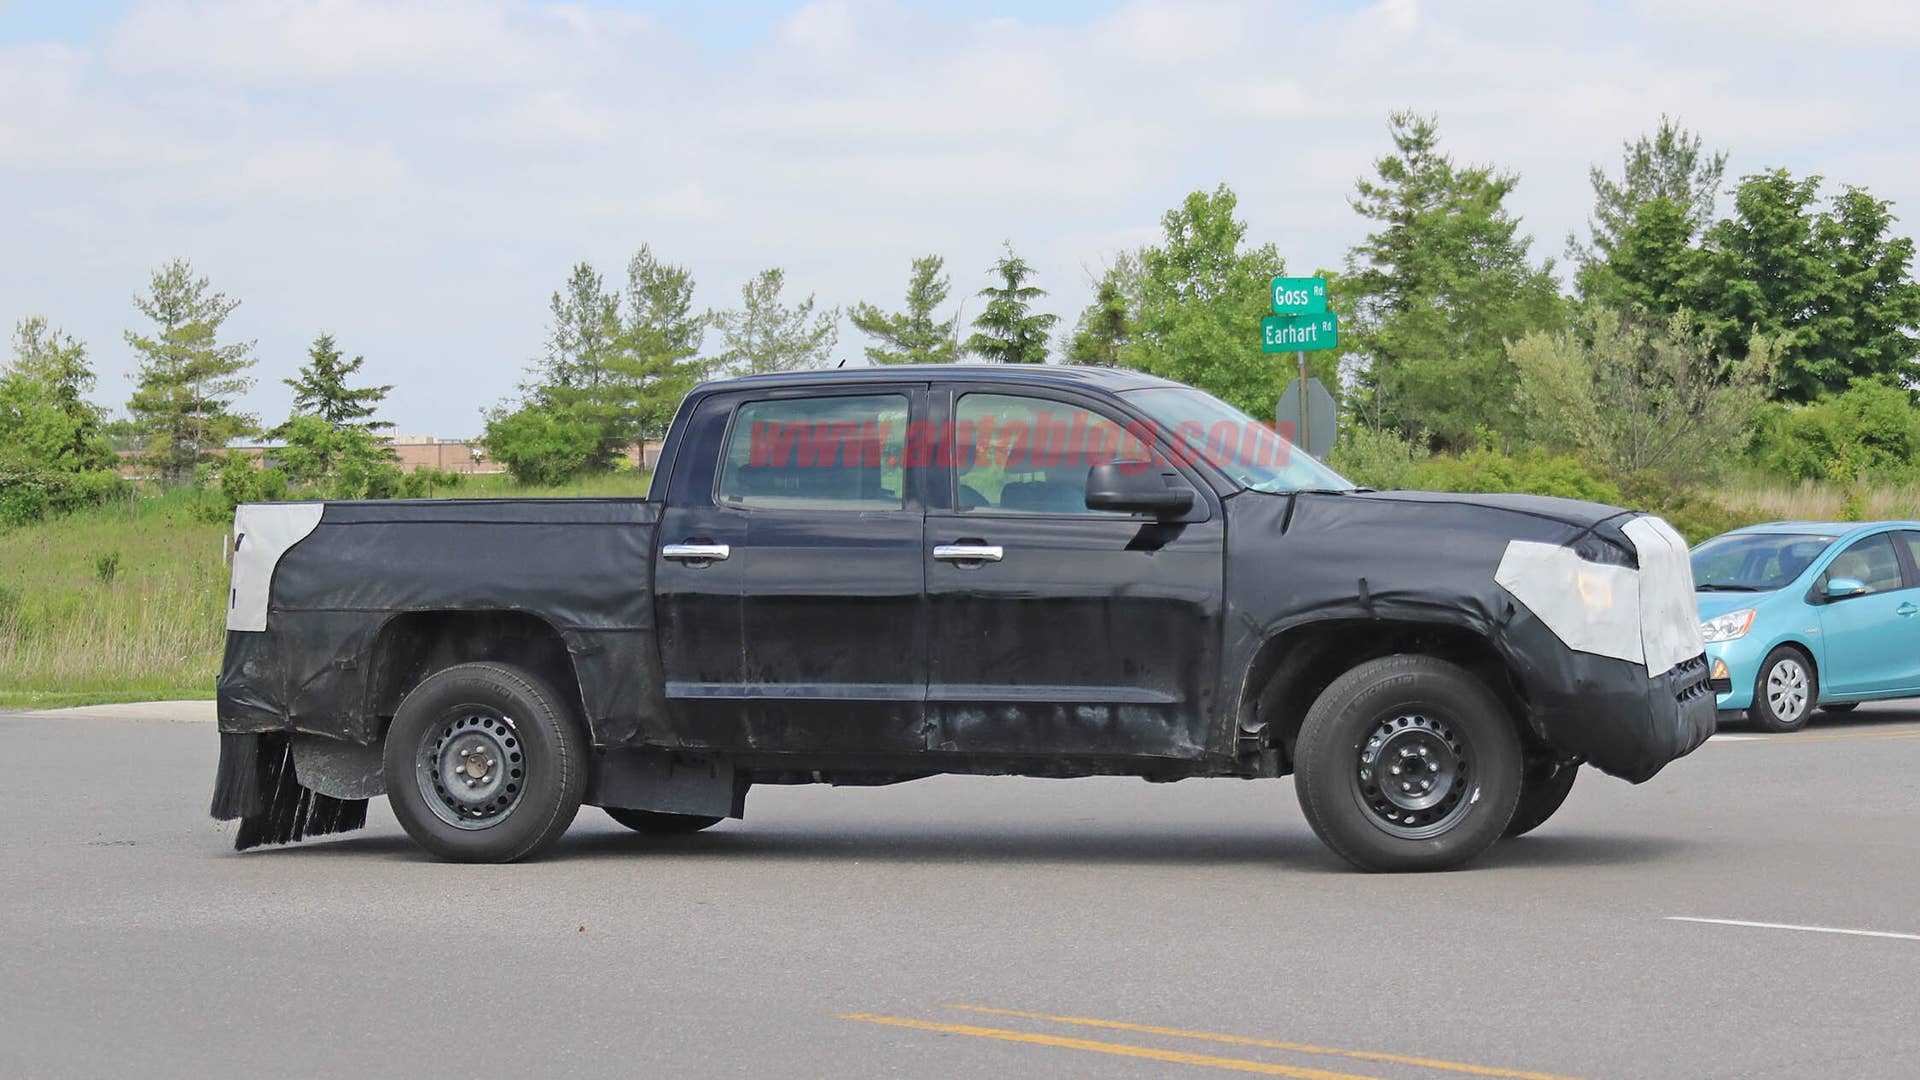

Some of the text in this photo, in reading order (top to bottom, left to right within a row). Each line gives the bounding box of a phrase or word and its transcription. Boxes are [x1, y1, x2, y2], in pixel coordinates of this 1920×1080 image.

[1275, 286, 1323, 305] Goss Rd
[1265, 321, 1332, 344] Earhart Rd
